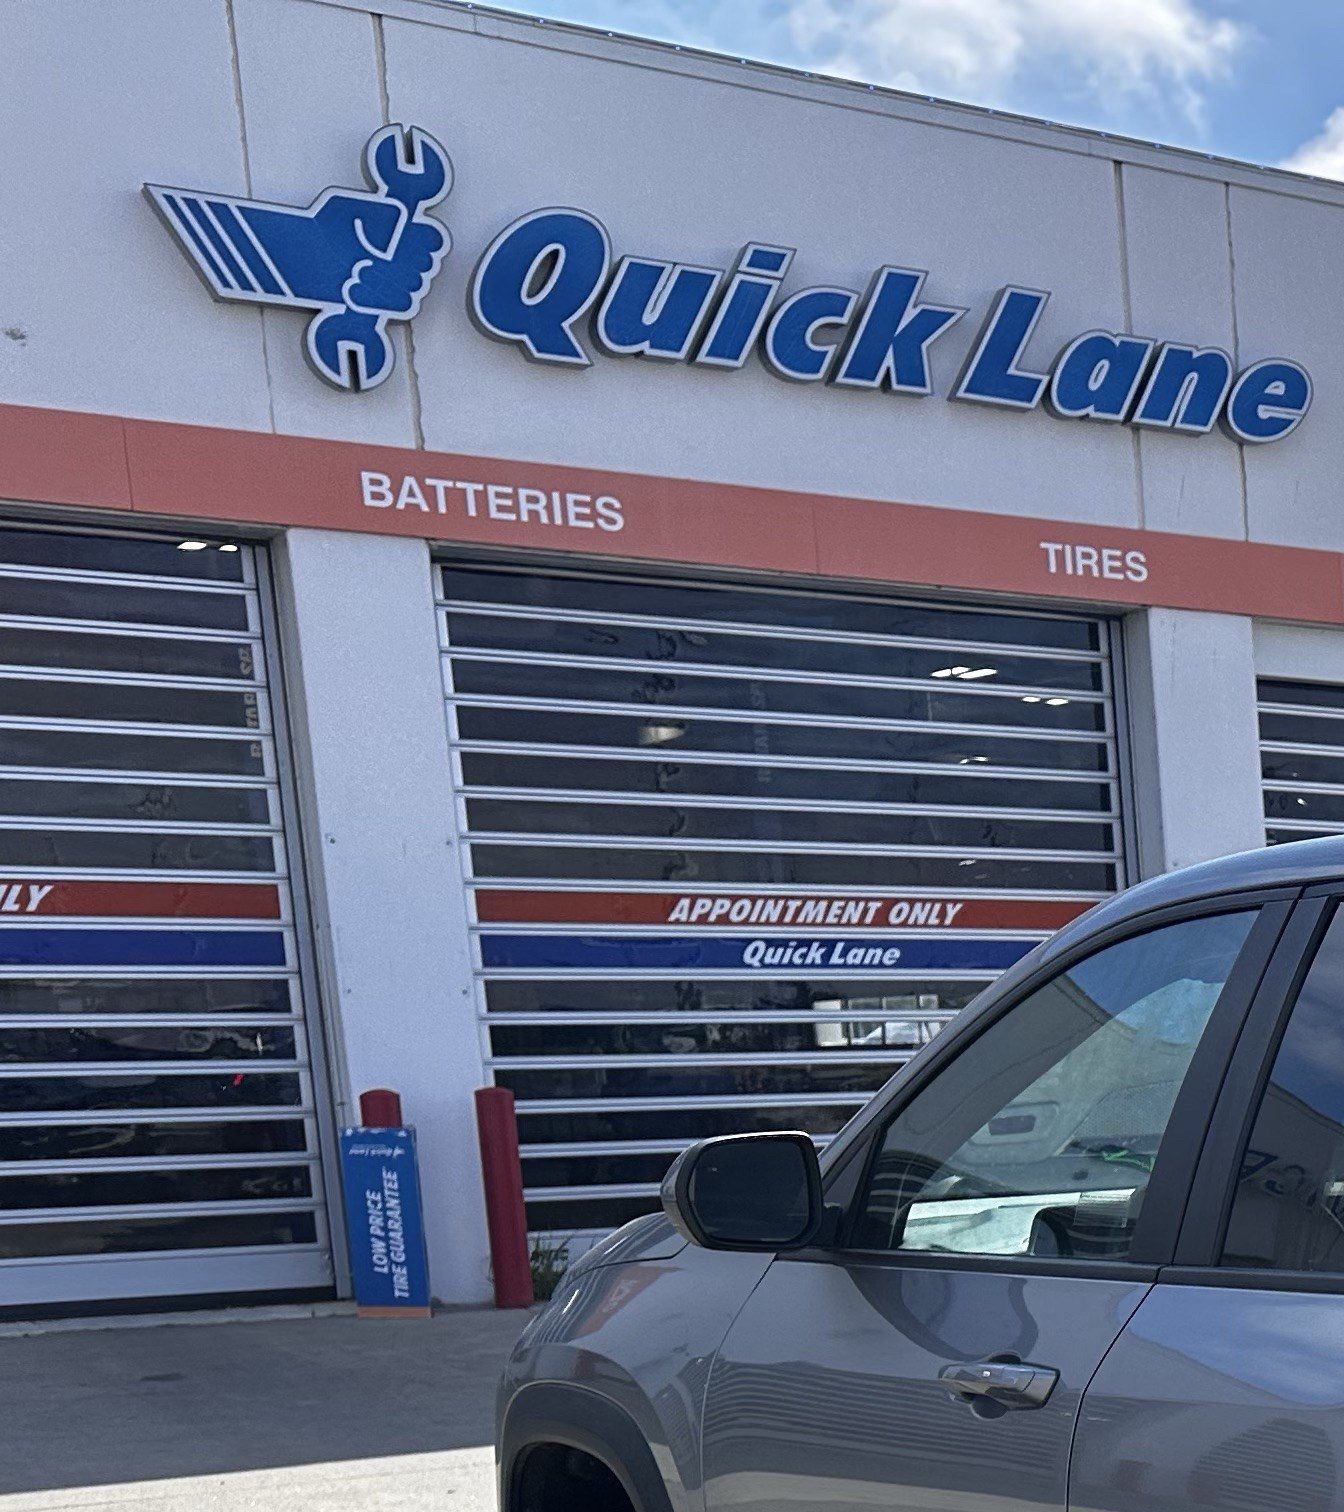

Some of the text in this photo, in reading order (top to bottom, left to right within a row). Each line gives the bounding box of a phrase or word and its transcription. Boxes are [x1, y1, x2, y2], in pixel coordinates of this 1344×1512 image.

[468, 206, 1314, 444] Quick Lane
[360, 471, 625, 532] BATTERIES
[1039, 541, 1149, 582] TIRES
[668, 897, 963, 926] APPOINTMENT ONLY
[742, 939, 901, 968] Quick Lane
[365, 1188, 389, 1275] LOW PRICE
[382, 1165, 410, 1299] TIRE GUARANTEE
